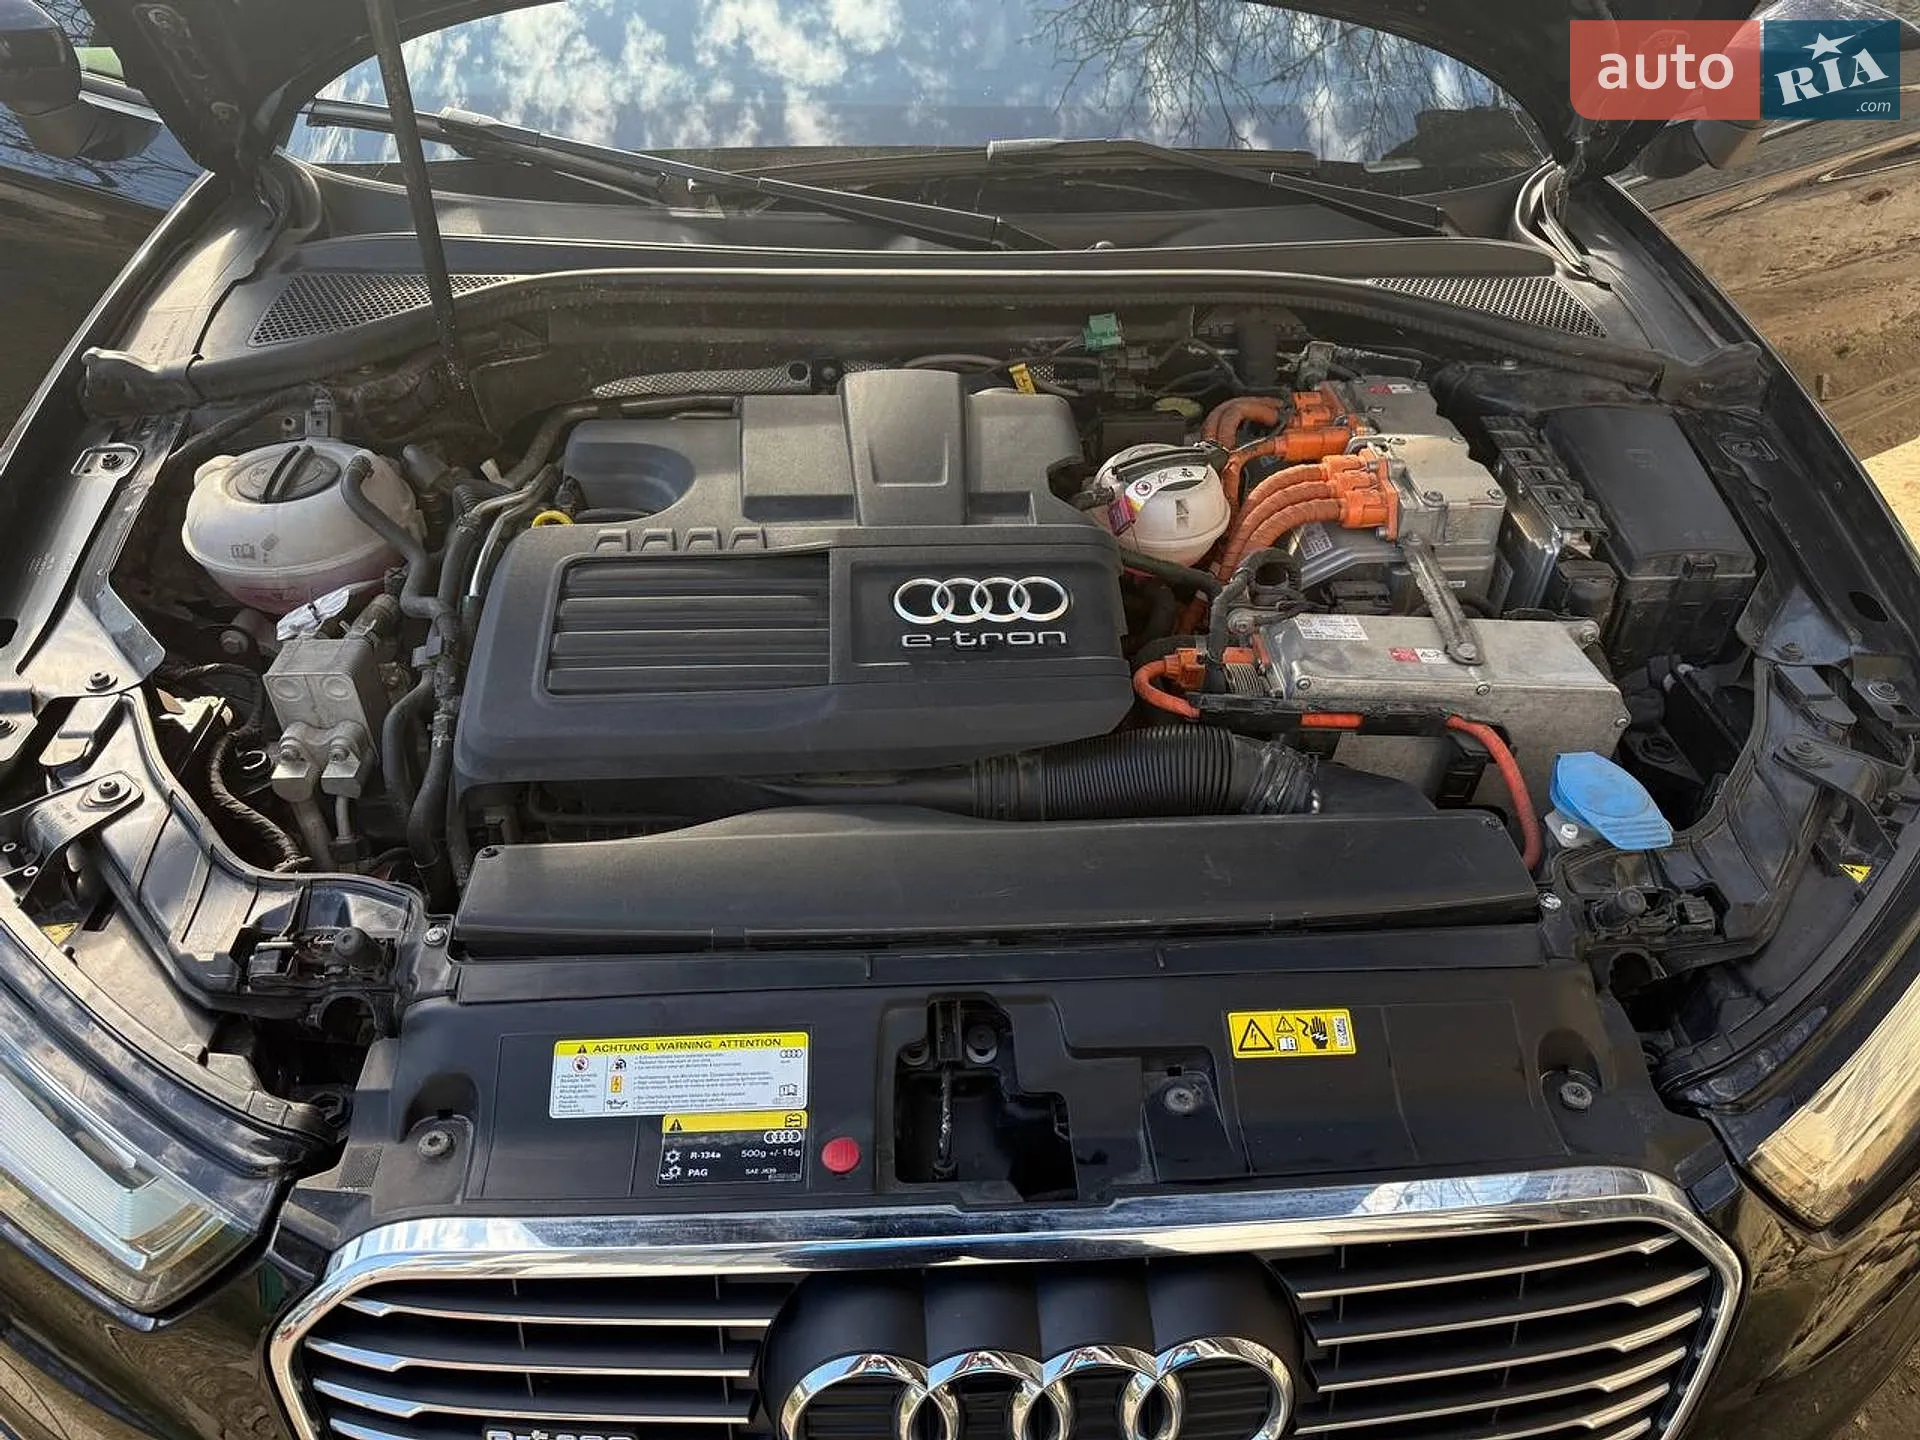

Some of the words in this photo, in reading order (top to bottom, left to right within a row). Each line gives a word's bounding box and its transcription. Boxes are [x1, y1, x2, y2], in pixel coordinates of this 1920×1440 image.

[902, 630, 1067, 648] e-tron
[592, 1042, 649, 1053] ACHTUNG
[656, 1040, 711, 1050] WARNING
[719, 1038, 781, 1048] ATTENTION
[690, 1151, 721, 1160] R-134a
[741, 1149, 766, 1159] 500g
[783, 1148, 801, 1157] 15g
[688, 1168, 708, 1177] PAG
